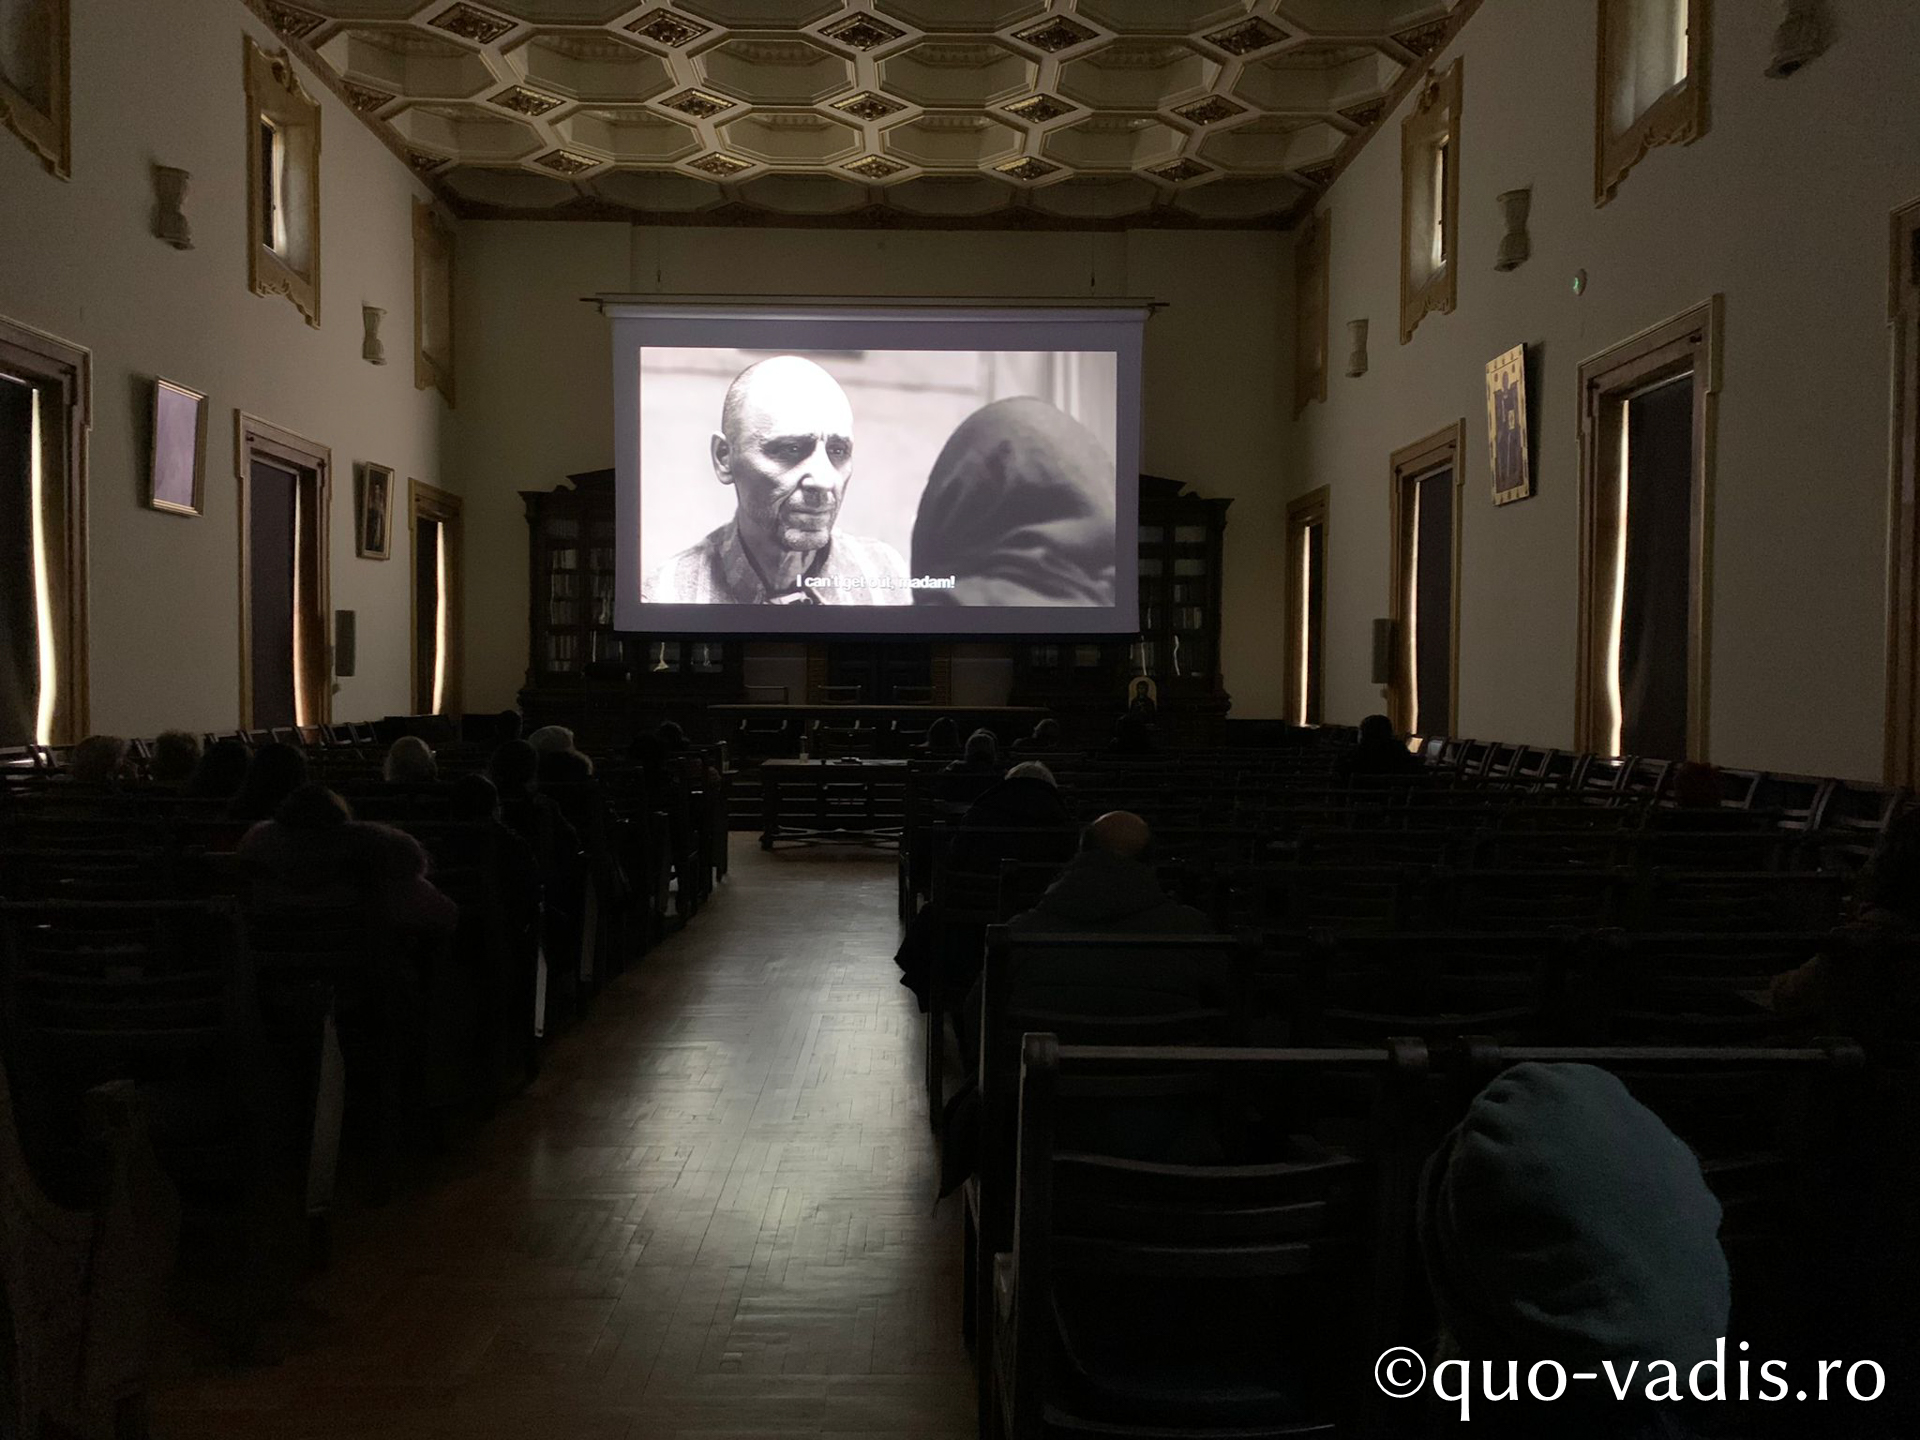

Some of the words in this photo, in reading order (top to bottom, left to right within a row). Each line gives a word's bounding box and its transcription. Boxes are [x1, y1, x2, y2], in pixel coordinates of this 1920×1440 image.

[796, 574, 802, 588] I
[804, 574, 840, 588] can't
[841, 575, 865, 592] get
[868, 575, 896, 591] out,
[898, 575, 956, 589] madam!
